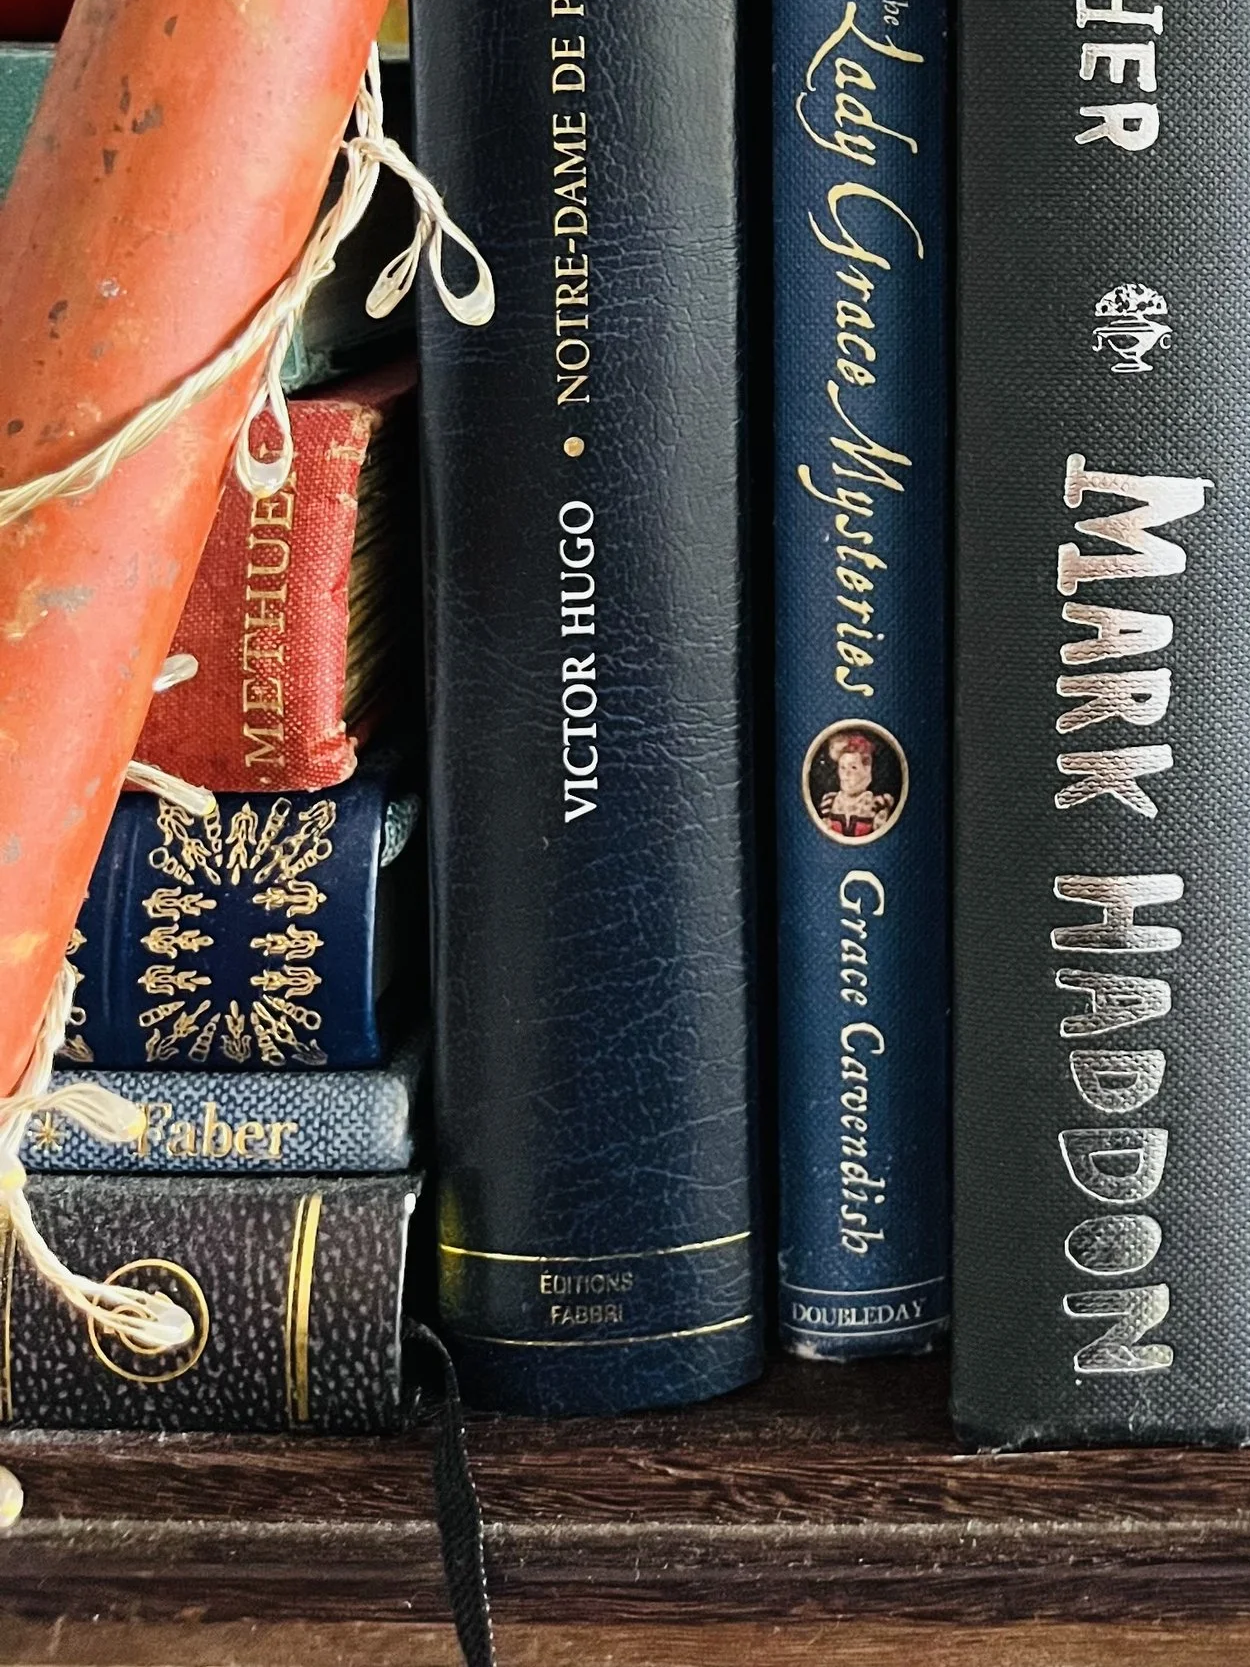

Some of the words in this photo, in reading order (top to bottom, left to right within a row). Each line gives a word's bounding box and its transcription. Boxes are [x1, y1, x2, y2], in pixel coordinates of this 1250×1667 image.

[550, 34, 587, 95] DE
[795, 0, 925, 166] Lady
[552, 111, 591, 406] NOTRE-DAME
[807, 181, 924, 387] Grace
[557, 498, 596, 638] HUGO
[797, 380, 913, 697] Mysteries
[1054, 452, 1214, 819] MARK
[561, 652, 599, 823] VICTOR
[838, 868, 887, 1008] Grace
[133, 1101, 299, 1159] Faber
[839, 1021, 888, 1255] Cavendish
[1050, 873, 1185, 1374] HADDON
[539, 1269, 635, 1295] ÉDITIONS
[550, 1303, 624, 1326] FABBRI
[791, 1296, 928, 1326] DOUBLEDAY
